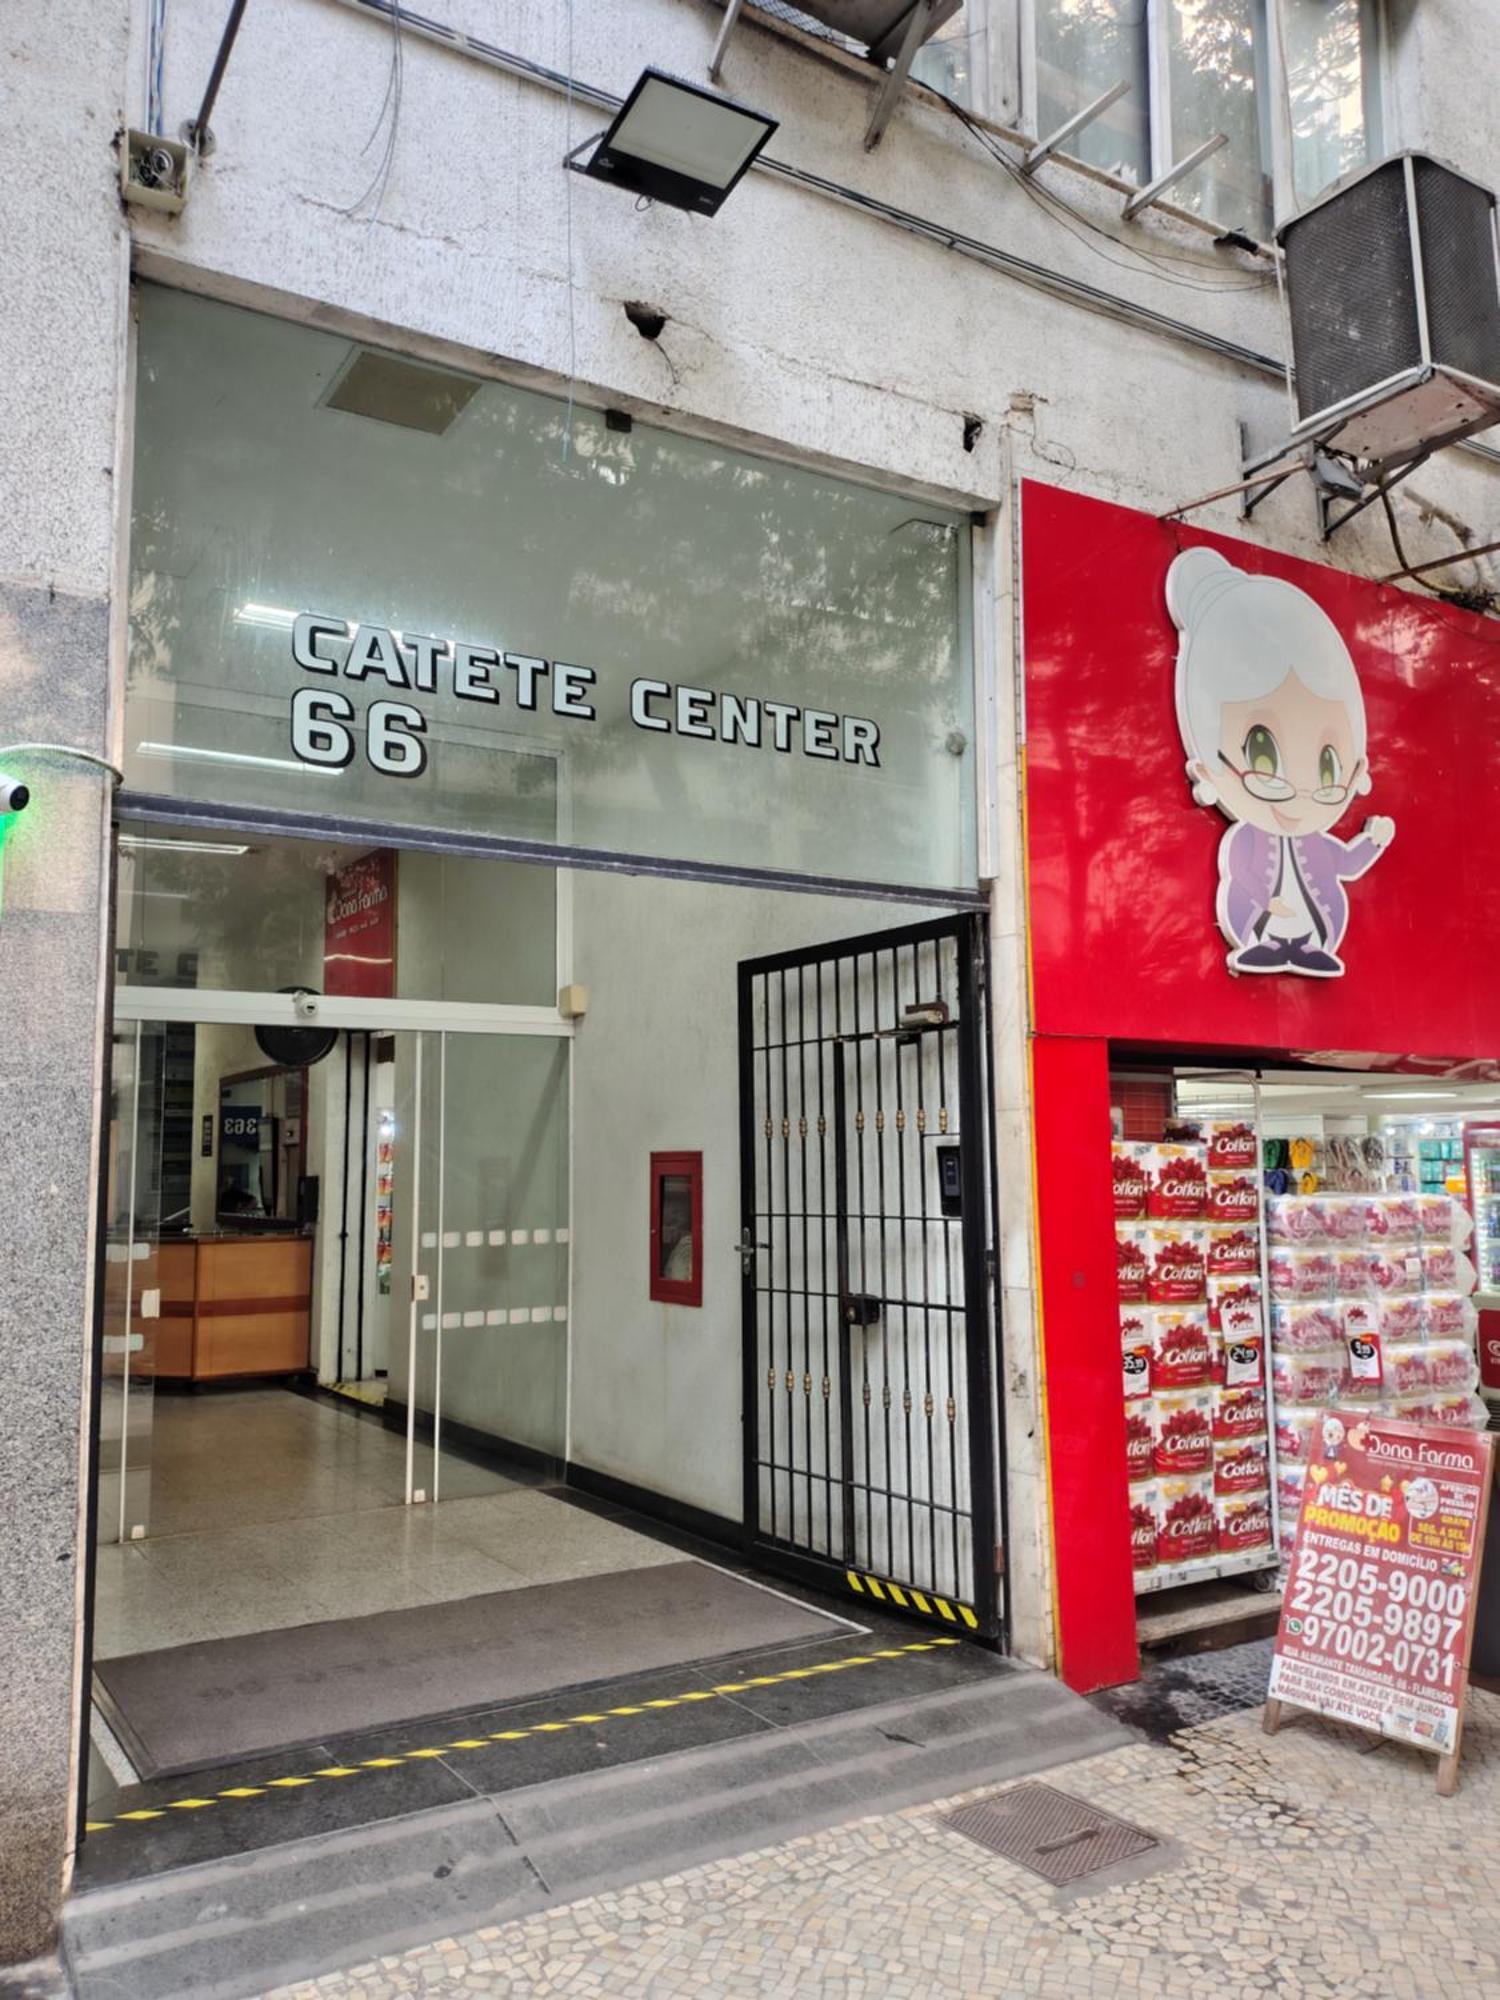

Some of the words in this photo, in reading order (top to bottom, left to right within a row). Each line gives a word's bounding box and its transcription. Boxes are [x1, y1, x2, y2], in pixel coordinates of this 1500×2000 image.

[291, 612, 596, 720] CATETE
[630, 677, 881, 768] CENTER
[290, 687, 427, 778] 66
[1216, 1137, 1255, 1153] Cotton
[1113, 1180, 1144, 1196] otton
[1163, 1180, 1205, 1197] Cotton
[1216, 1190, 1257, 1206] Cotton
[1215, 1245, 1256, 1260] Cotton
[1161, 1264, 1203, 1281] Cotton
[1165, 1349, 1208, 1365] Cotton
[1224, 1404, 1264, 1423] Cotton
[1127, 1439, 1151, 1456] tton
[1166, 1435, 1211, 1453] Cotton
[1367, 1434, 1414, 1459] Dona
[1417, 1442, 1474, 1469] Farma
[1221, 1461, 1264, 1478] Cotton
[1318, 1480, 1363, 1512] MÊS
[1364, 1493, 1393, 1519] DE
[1170, 1518, 1214, 1537] Cotton
[1229, 1516, 1269, 1536] Cotton
[1303, 1505, 1401, 1544] PROMOÇÃO
[1132, 1525, 1156, 1545] tton
[1303, 1531, 1362, 1553] ENTREGAS
[1363, 1544, 1380, 1559] EM
[1381, 1546, 1438, 1569] DOMICÍLIO
[1296, 1548, 1466, 1617] 2205-9000
[1290, 1580, 1462, 1651] 2205-9897
[1302, 1615, 1455, 1686] 97002-0731
[1281, 1660, 1339, 1686] PARCELAMOS
[1341, 1678, 1357, 1692] EM
[1392, 1692, 1413, 1709] SEM
[1415, 1700, 1446, 1718] JUROS
